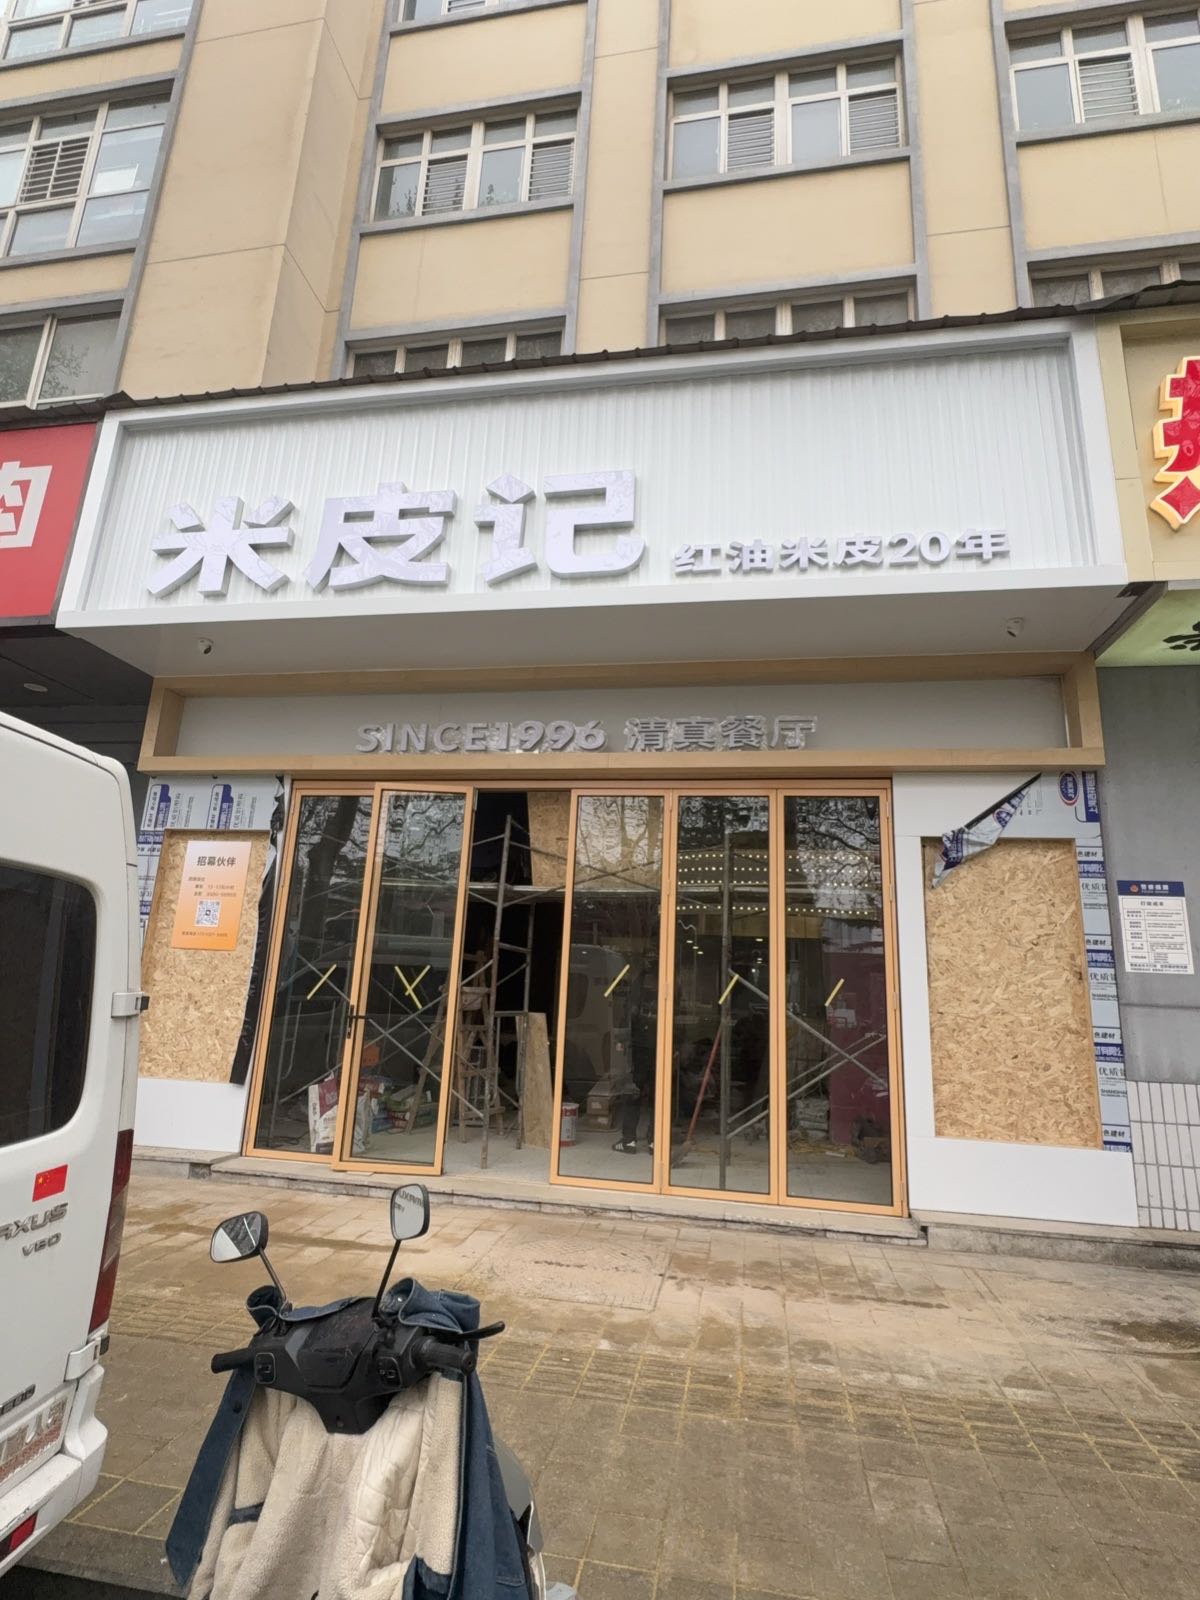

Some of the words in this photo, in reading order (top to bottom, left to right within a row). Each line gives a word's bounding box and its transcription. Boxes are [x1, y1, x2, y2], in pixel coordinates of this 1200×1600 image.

[148, 469, 647, 598] 米皮记
[673, 528, 1011, 576] 红油米皮20年
[624, 715, 818, 751] 清真餐厅
[197, 856, 236, 867] 招募伙伴
